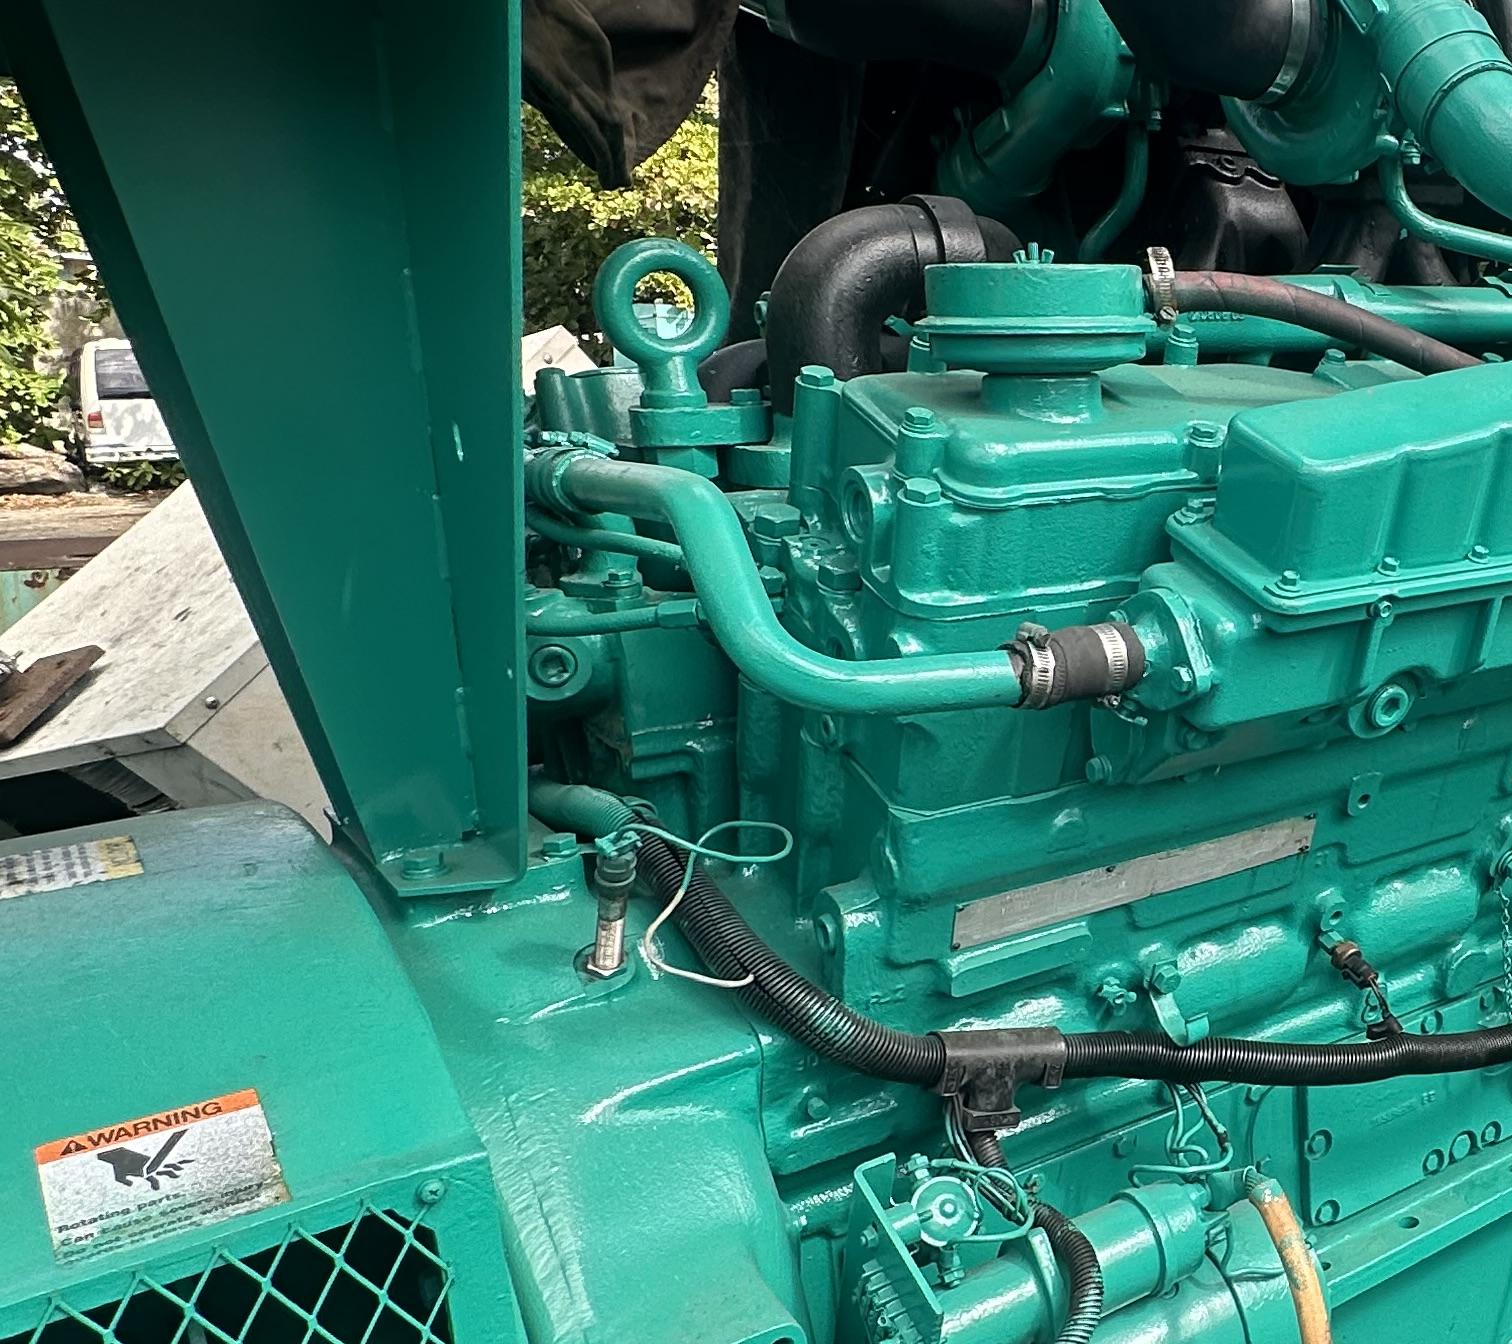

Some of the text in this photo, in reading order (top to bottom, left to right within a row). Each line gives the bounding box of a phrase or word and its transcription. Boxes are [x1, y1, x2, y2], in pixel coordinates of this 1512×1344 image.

[87, 1102, 222, 1147] WARNING
[57, 1207, 130, 1233] Rotating
[61, 1232, 94, 1247] Can
[100, 1215, 153, 1235] cause
